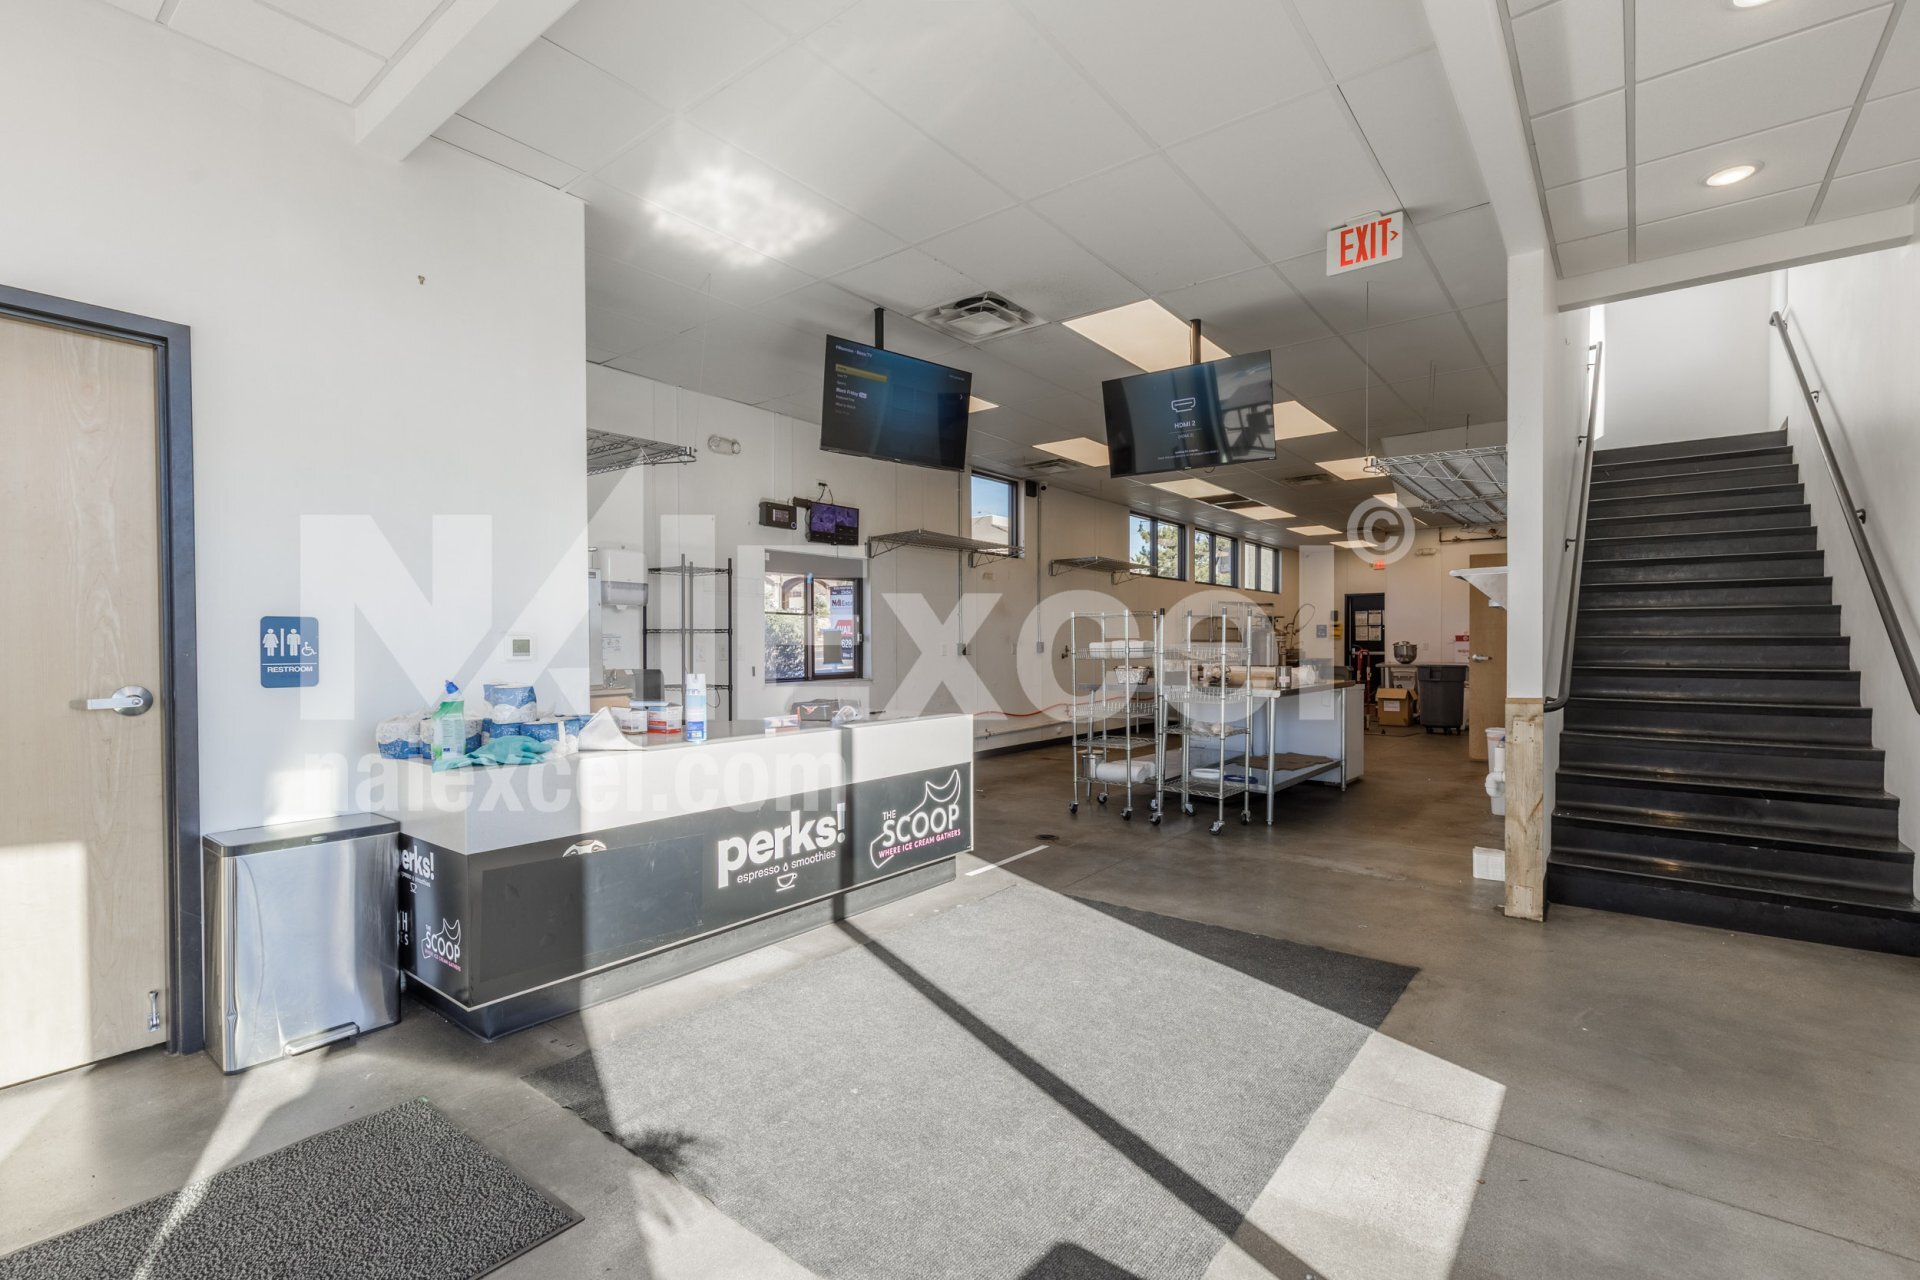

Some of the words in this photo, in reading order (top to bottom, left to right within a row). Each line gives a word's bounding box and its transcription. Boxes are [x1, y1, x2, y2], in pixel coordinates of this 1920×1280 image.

[1340, 217, 1392, 267] EXIT
[1174, 421, 1191, 429] HDMI
[267, 665, 313, 673] RESTROOM
[882, 809, 897, 820] THE
[882, 803, 960, 848] SCOOP
[718, 802, 846, 889] perks!
[878, 845, 901, 859] WHERE
[902, 842, 913, 853] ICE
[914, 837, 935, 849] CREAM
[936, 828, 961, 842] GATHERS
[401, 845, 435, 880] erks!
[737, 864, 780, 884] espresso
[791, 849, 837, 869] smoothies
[425, 931, 461, 963] SCOOP
